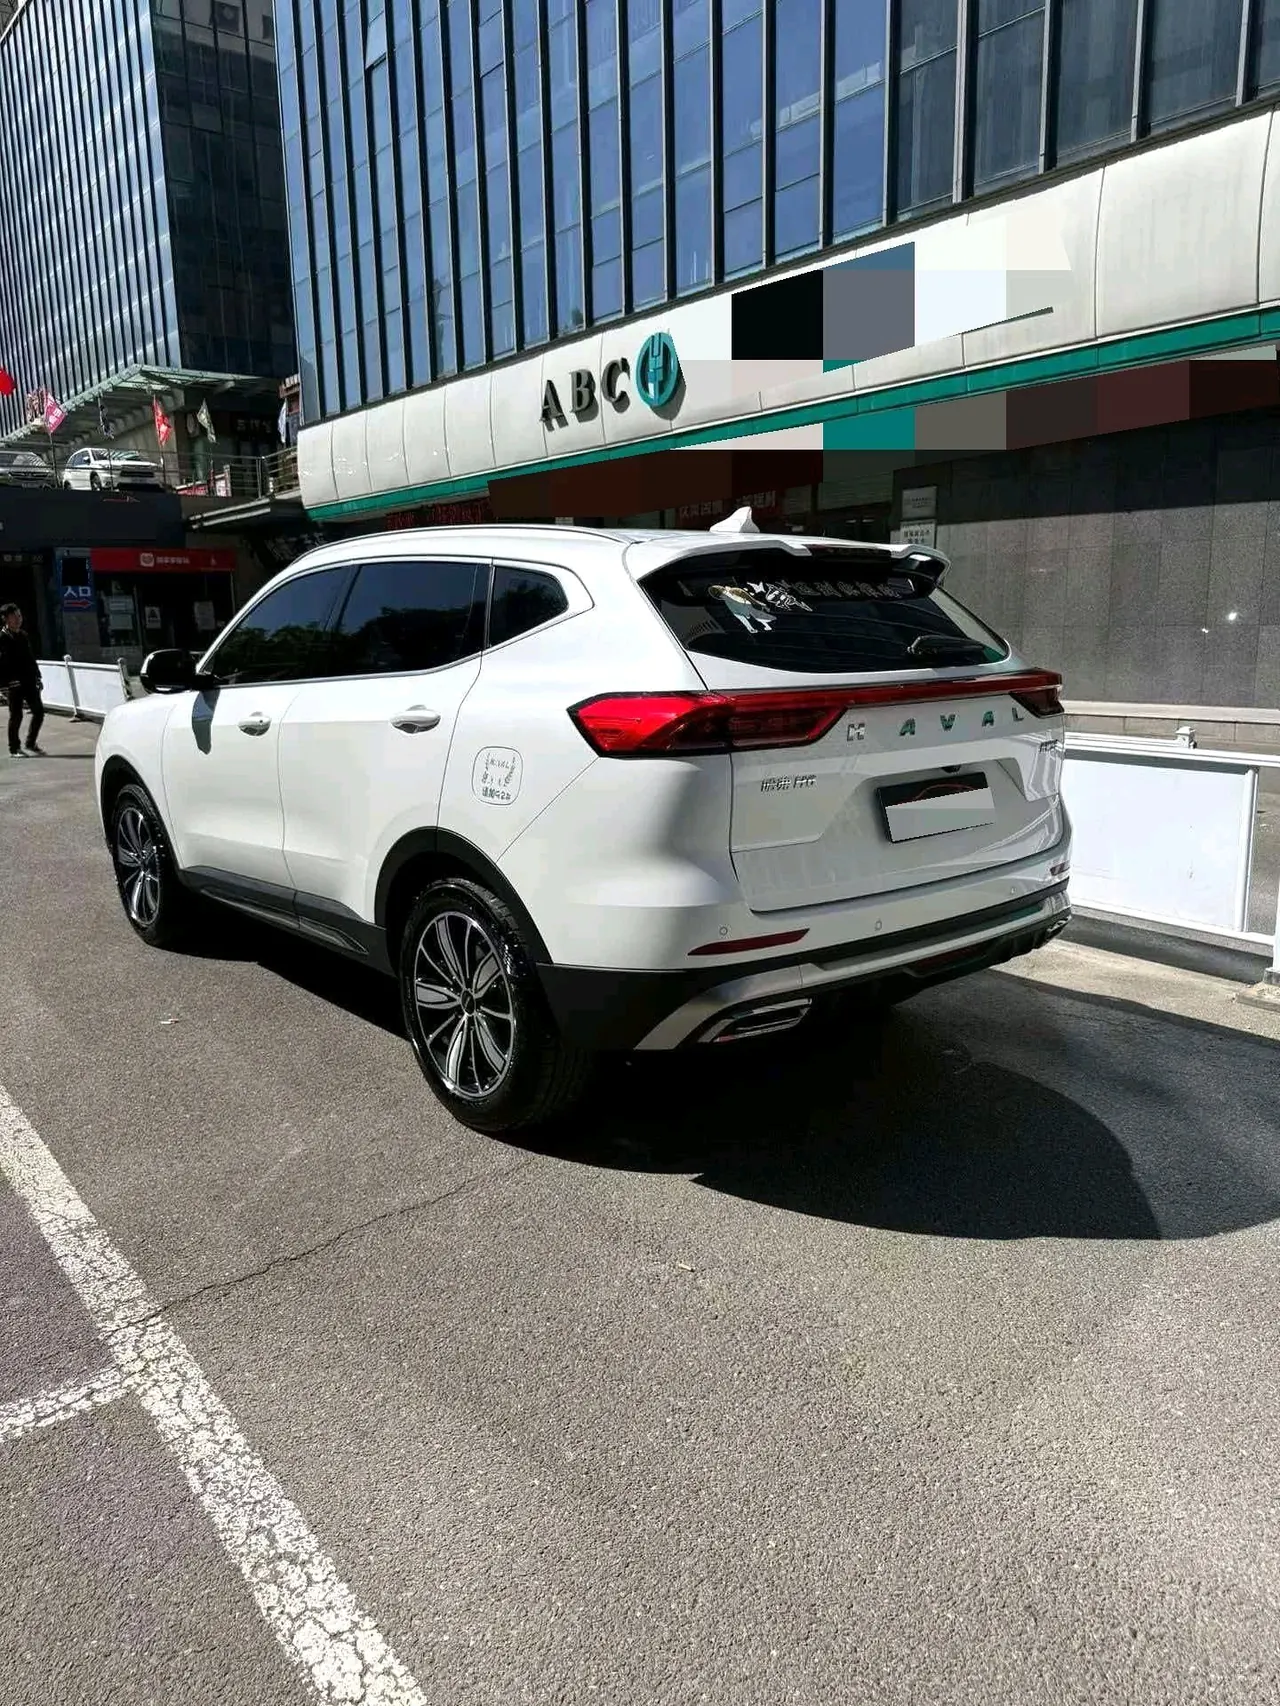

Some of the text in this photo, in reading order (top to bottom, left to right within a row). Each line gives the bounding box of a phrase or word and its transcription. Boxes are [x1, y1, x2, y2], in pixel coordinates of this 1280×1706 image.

[540, 357, 631, 424] ABC
[63, 585, 92, 598] 入口
[846, 707, 1024, 742] HAVAL
